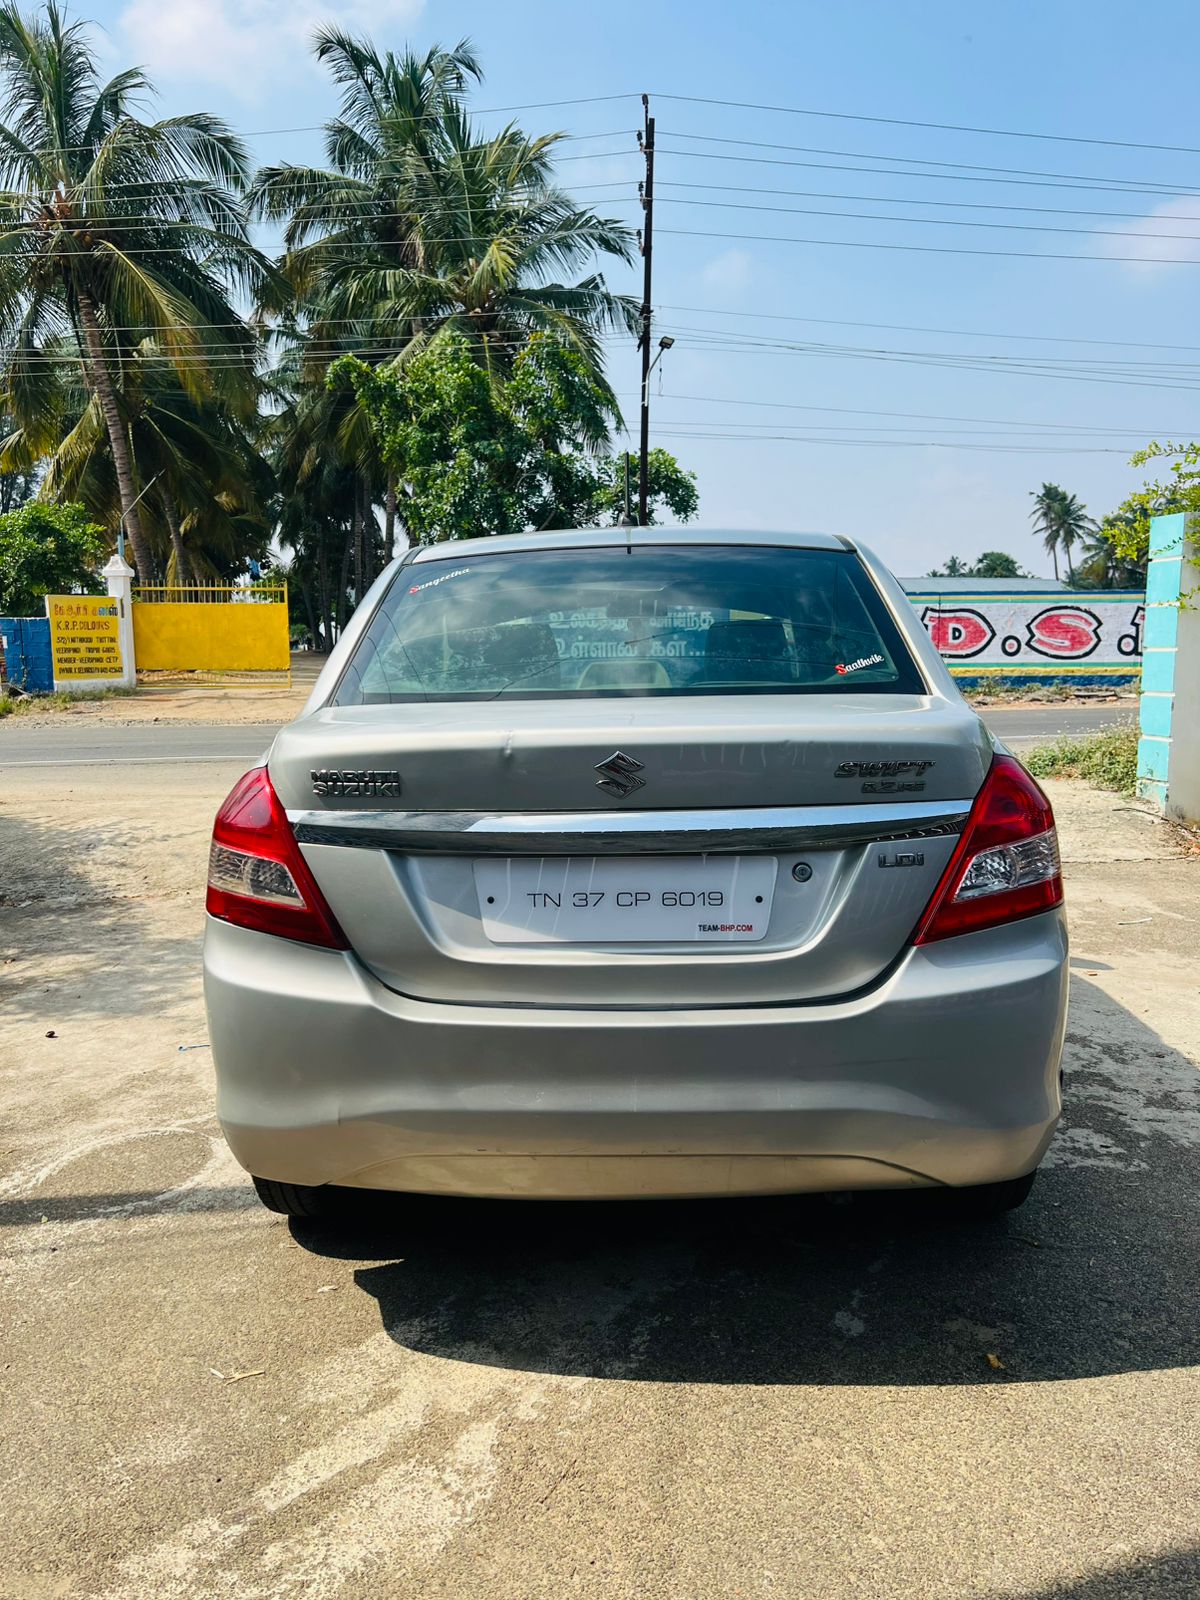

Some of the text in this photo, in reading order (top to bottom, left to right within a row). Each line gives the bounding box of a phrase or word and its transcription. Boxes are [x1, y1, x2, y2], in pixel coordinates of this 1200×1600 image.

[409, 568, 470, 594] Sangeetha
[834, 654, 885, 676] Saathvik
[310, 769, 400, 782] MARUTI
[834, 761, 936, 778] SWIFT
[312, 781, 401, 797] SUZUKI
[526, 891, 724, 908] TN 37 CP 6019
